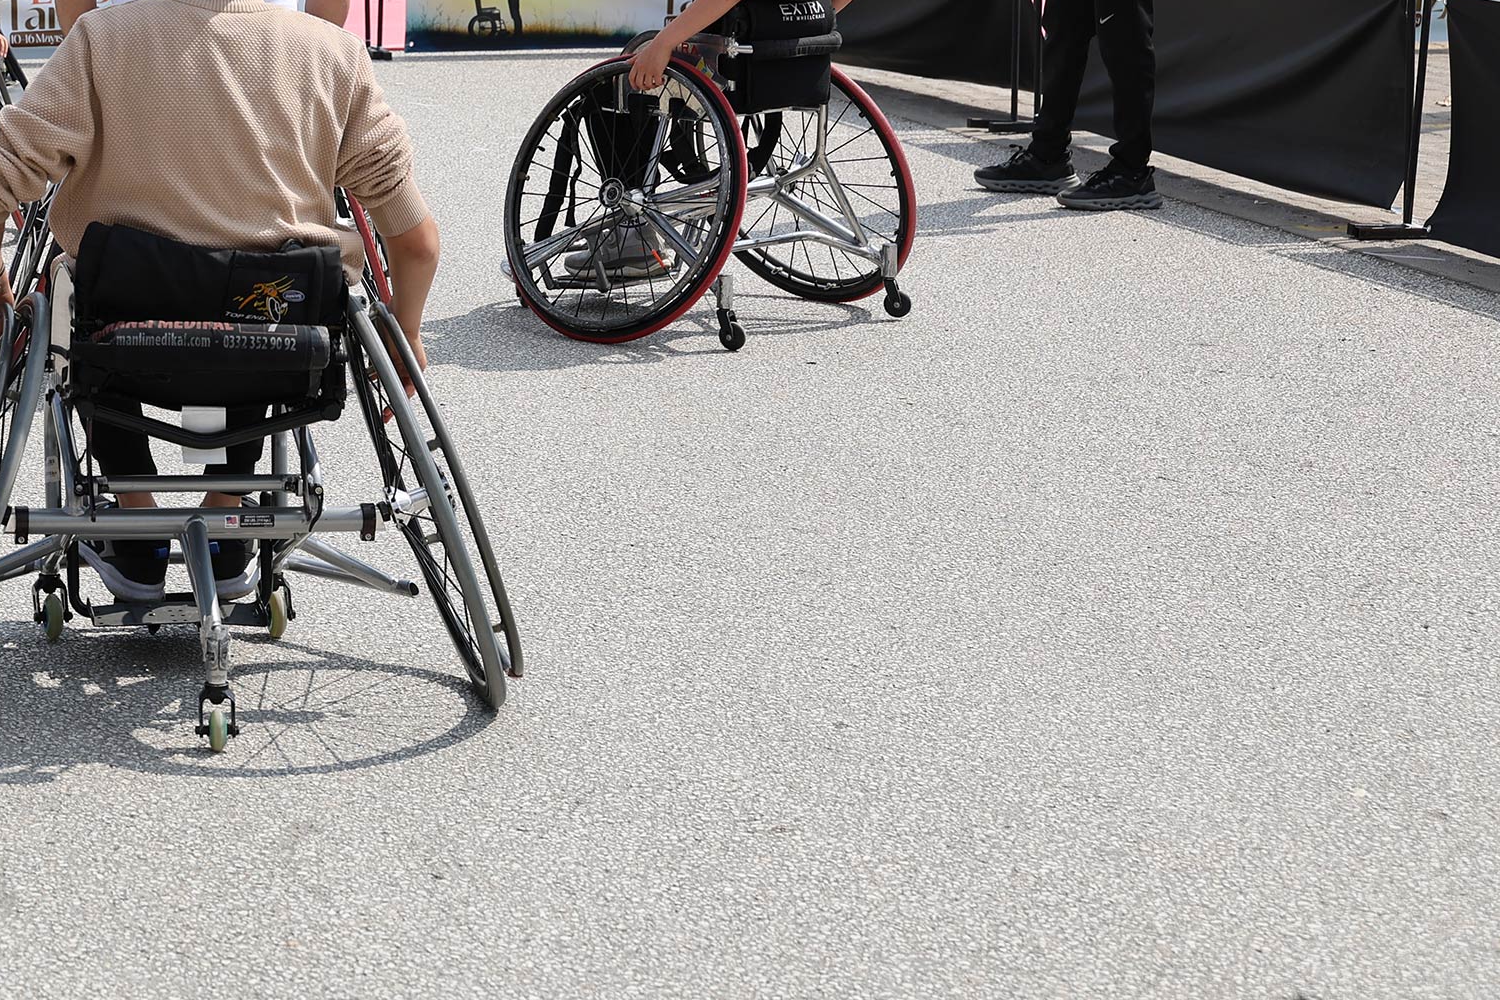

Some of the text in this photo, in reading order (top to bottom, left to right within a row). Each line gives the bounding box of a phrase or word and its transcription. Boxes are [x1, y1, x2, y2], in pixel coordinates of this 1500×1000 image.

[779, 0, 825, 16] EXTRA
[225, 310, 245, 318] TOP
[116, 332, 211, 347] manlimedikal.com
[223, 335, 247, 349] 0332
[250, 336, 267, 350] 352
[270, 337, 282, 350] 90
[285, 338, 297, 351] 92
